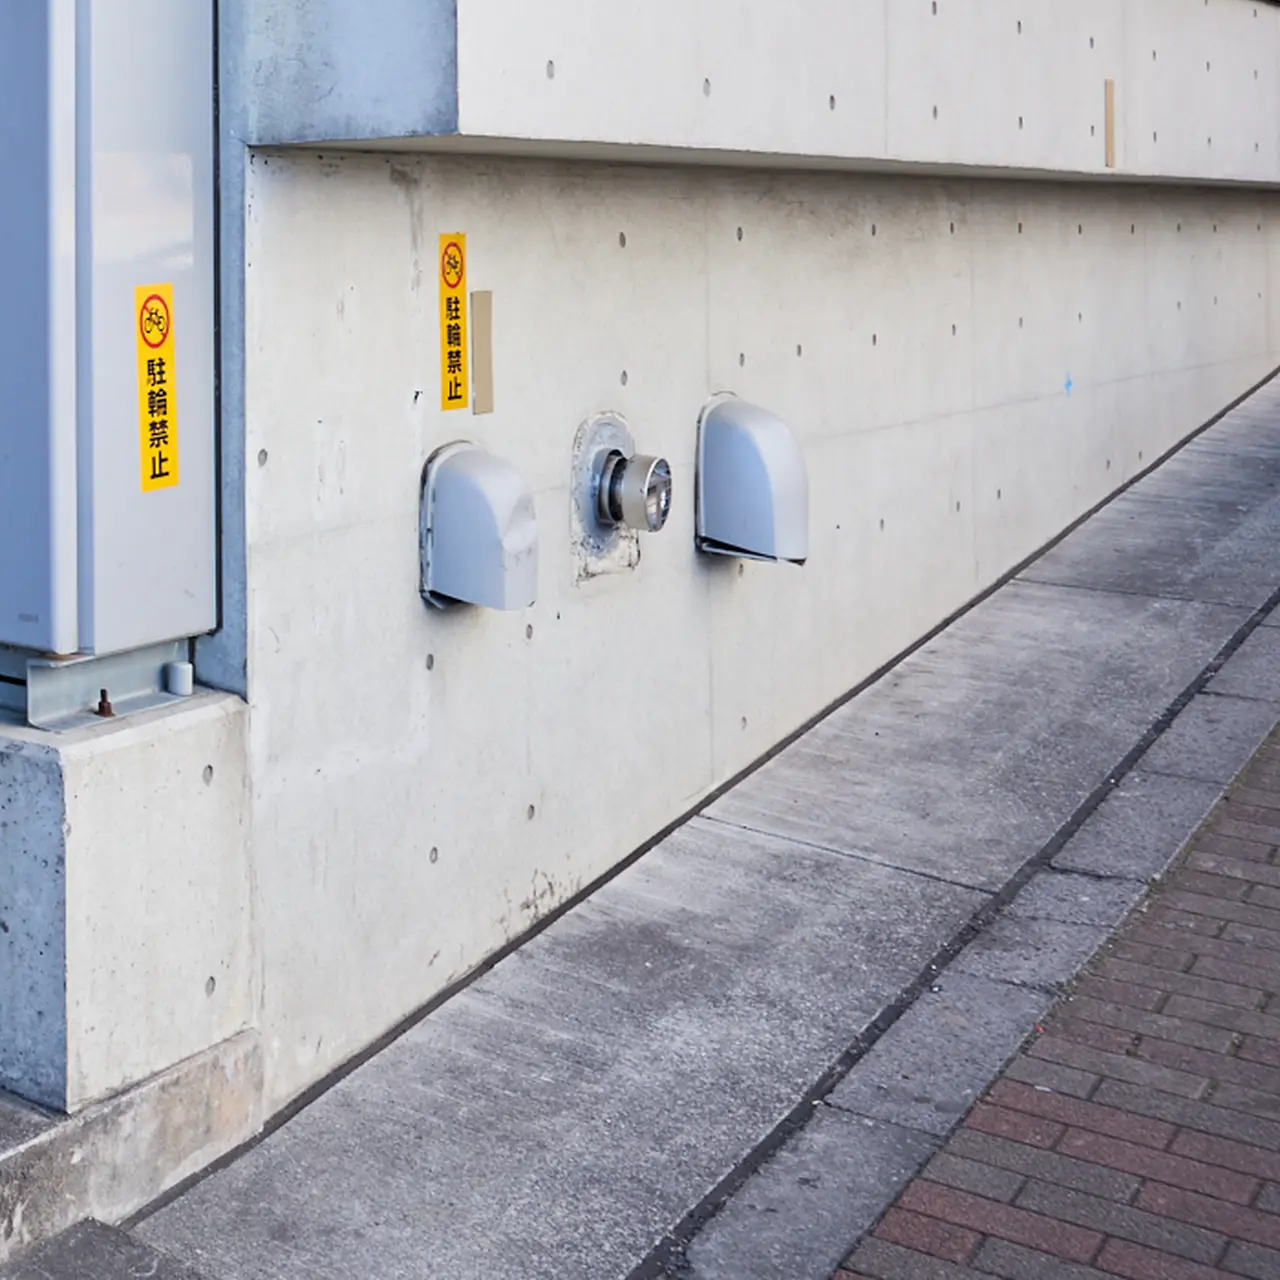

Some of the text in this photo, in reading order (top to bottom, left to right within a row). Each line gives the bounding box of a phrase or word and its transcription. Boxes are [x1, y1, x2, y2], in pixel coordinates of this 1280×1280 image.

[444, 295, 463, 402] 駐輪禁止
[146, 357, 170, 481] 駐輪禁止
